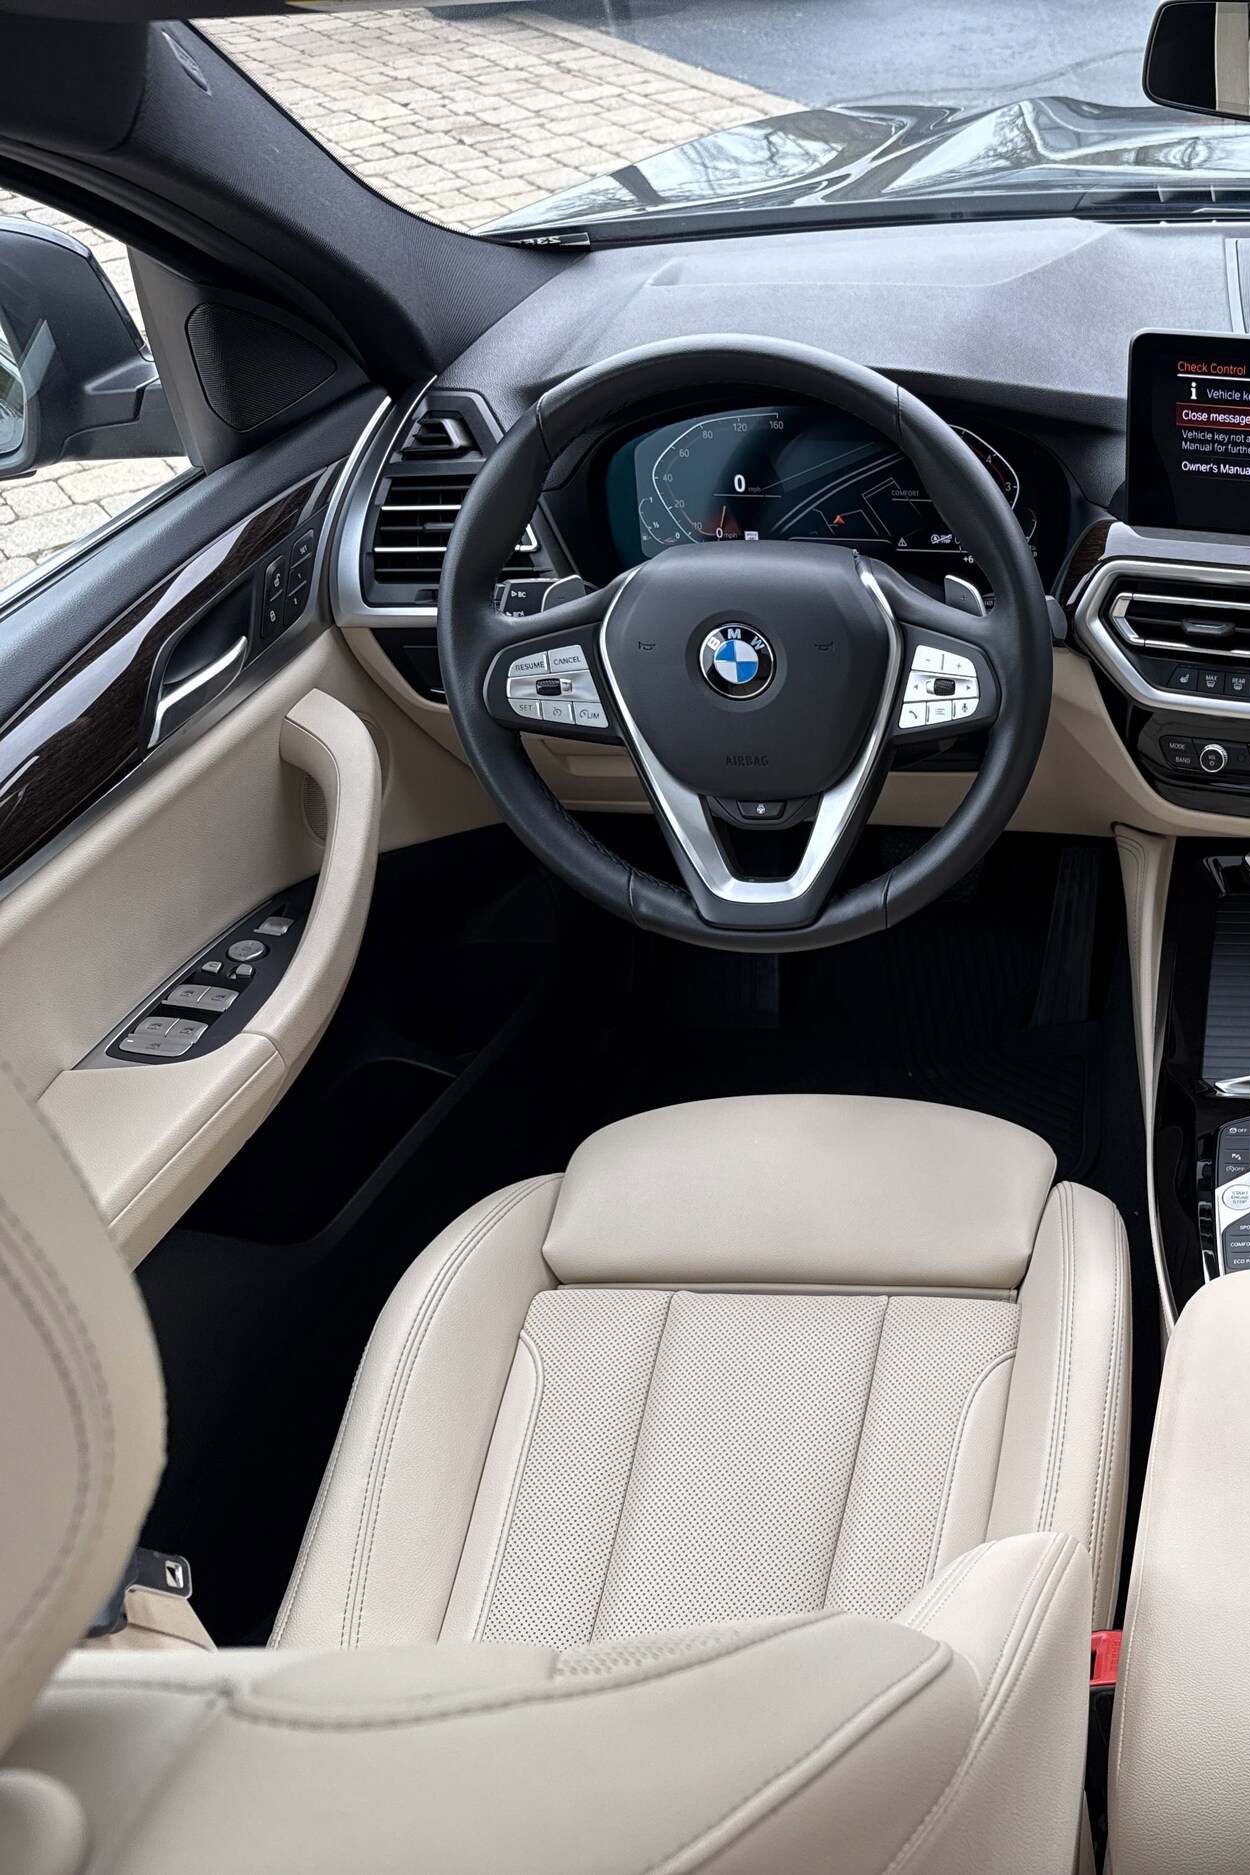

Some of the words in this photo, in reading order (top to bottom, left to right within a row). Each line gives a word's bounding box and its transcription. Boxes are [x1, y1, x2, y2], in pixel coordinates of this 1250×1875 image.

[1178, 361, 1208, 373] Check
[1211, 364, 1246, 375] Control
[1207, 389, 1241, 400] Vehicle
[1182, 410, 1208, 421] Close
[733, 423, 747, 432] 120
[769, 421, 784, 430] 160
[703, 430, 713, 439] 80
[1182, 430, 1213, 441] Vehicle
[1214, 432, 1228, 443] key
[1230, 434, 1245, 443] not
[1182, 441, 1213, 452] Manual
[1214, 443, 1226, 453] for
[679, 449, 690, 458] 60
[986, 456, 992, 465] 4
[1182, 461, 1218, 473] Owner's
[662, 474, 673, 482] 40
[734, 474, 746, 493] 0
[1005, 482, 1011, 491] 3
[674, 500, 685, 508] 20
[694, 522, 703, 530] 10
[716, 527, 724, 538] 0
[706, 628, 765, 651] BMW
[554, 656, 581, 666] CANCEL
[515, 661, 545, 672] RESUME
[1169, 742, 1185, 750] MODE
[726, 755, 769, 767] AIRBAG
